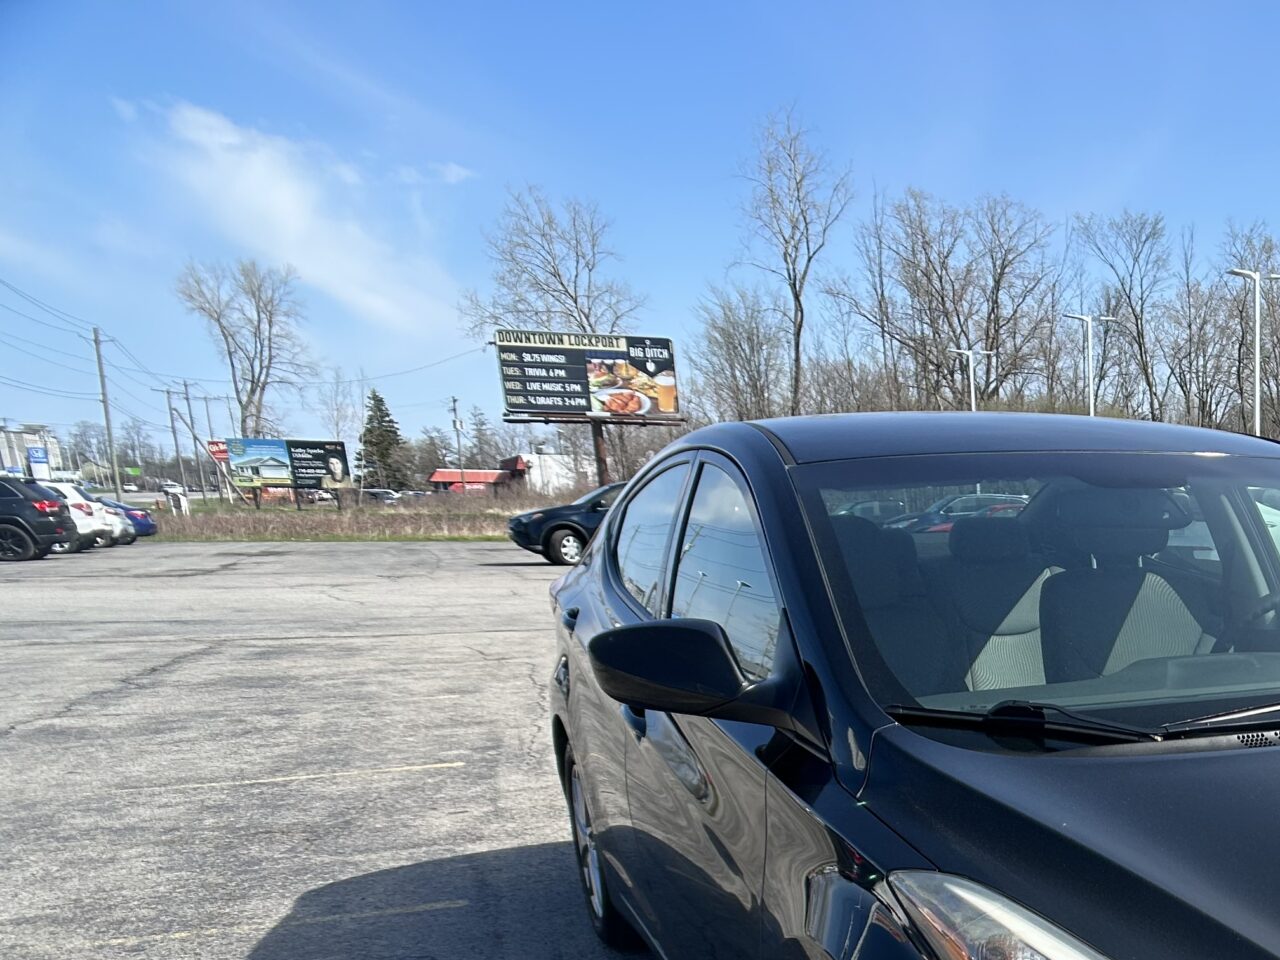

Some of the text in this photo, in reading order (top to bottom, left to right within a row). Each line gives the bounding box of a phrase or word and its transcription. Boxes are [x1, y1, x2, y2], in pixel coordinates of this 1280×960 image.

[498, 331, 620, 348] DOWNTOWN LOCKPORT
[500, 352, 519, 361] MON:
[629, 347, 669, 359] BIG DITCH
[502, 366, 522, 375] TUES:
[524, 367, 548, 377] TRIVIA
[504, 381, 523, 389] WED:
[526, 382, 541, 390] LIVE
[541, 383, 564, 392] MUSIC
[506, 395, 527, 404] THUR:
[536, 396, 563, 405] DRAFTS
